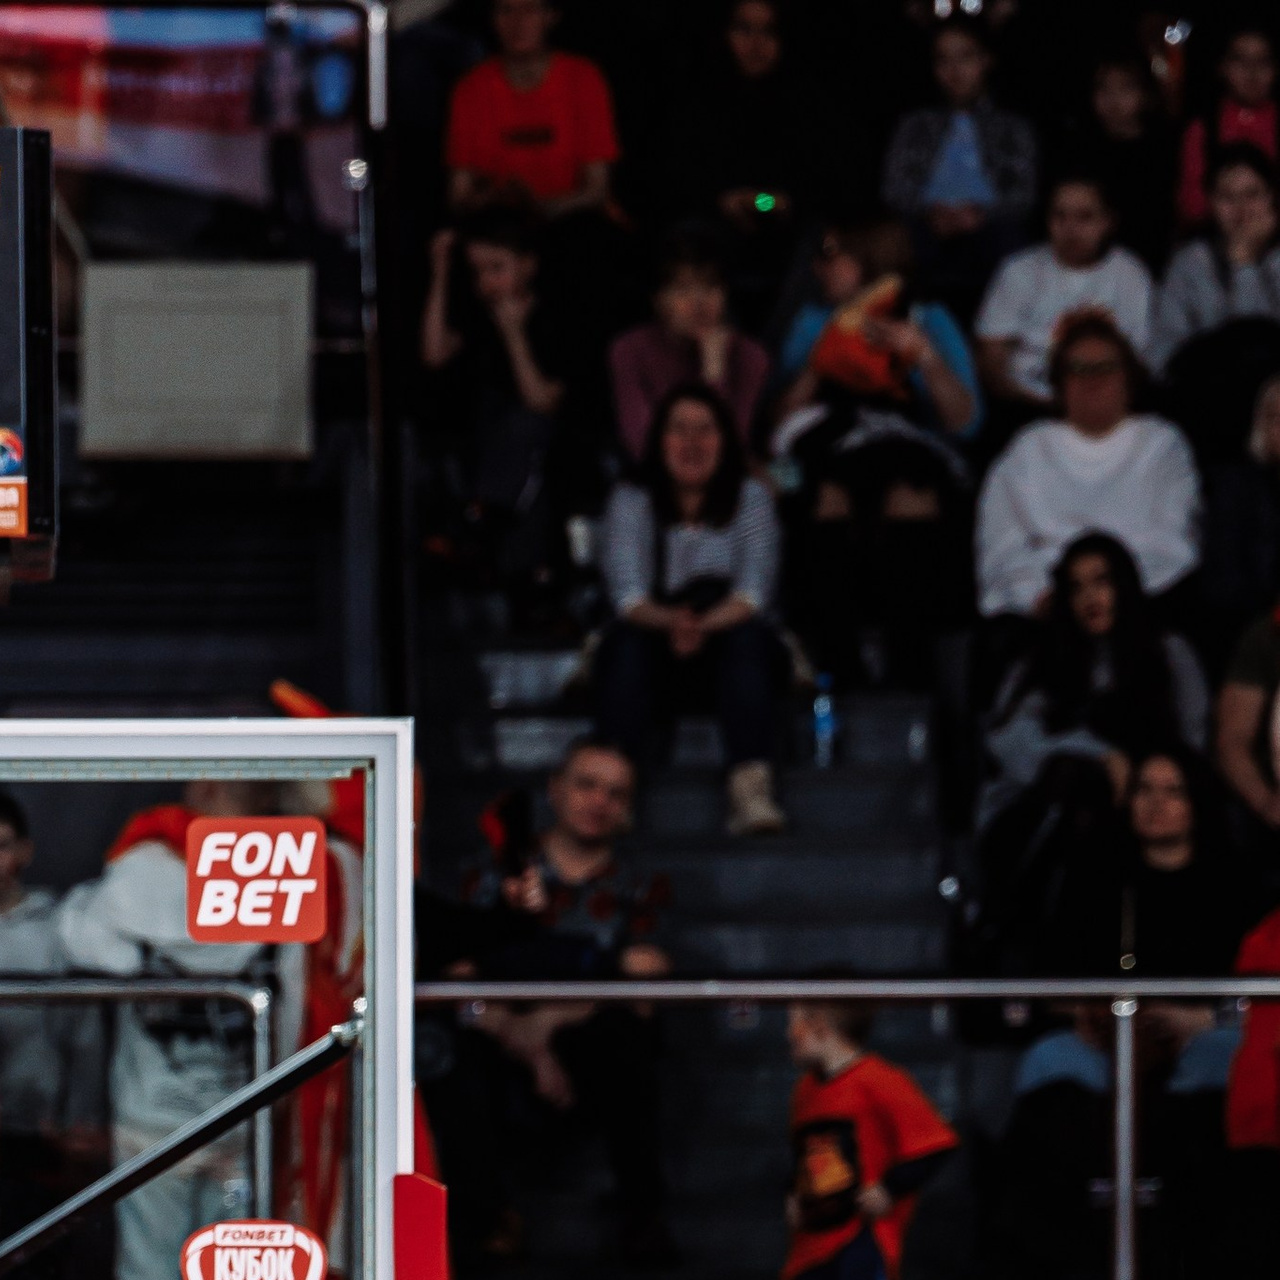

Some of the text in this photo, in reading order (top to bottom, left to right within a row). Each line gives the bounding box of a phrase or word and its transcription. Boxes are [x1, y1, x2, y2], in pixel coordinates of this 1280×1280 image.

[196, 831, 317, 877] FON
[196, 879, 317, 926] BET
[221, 1229, 287, 1241] FONBET
